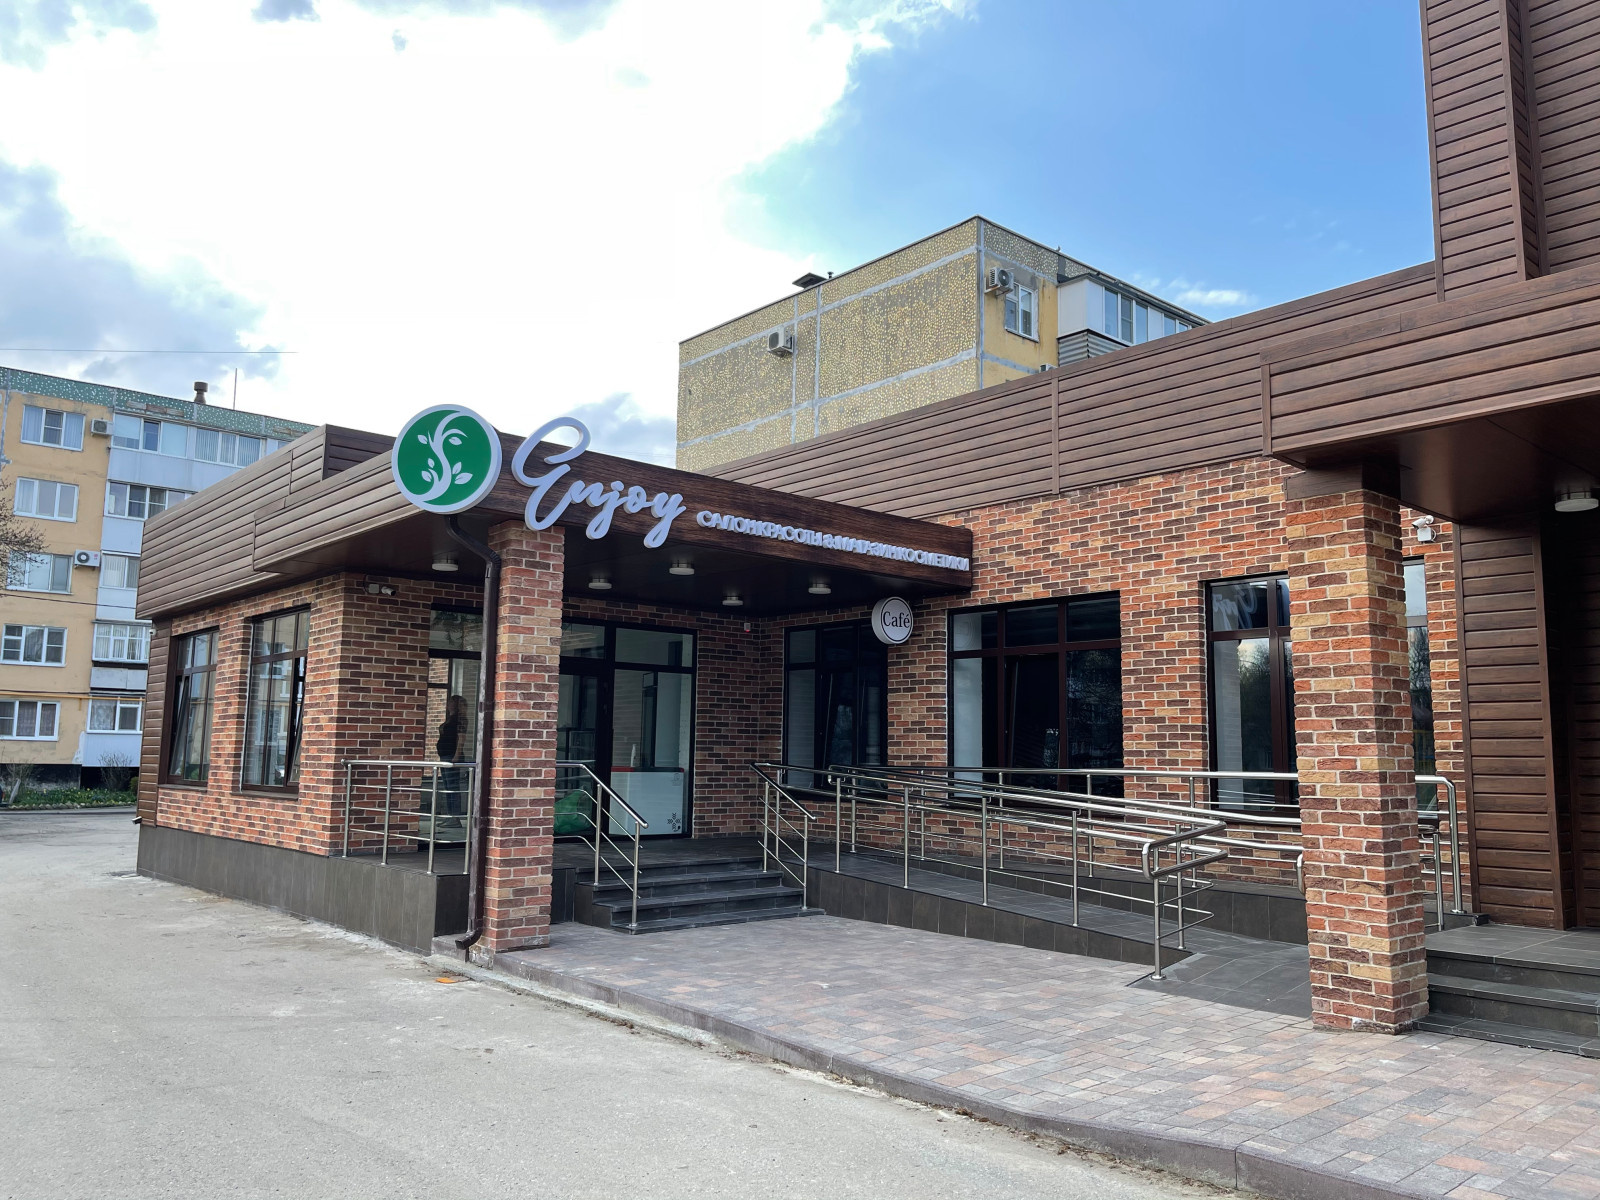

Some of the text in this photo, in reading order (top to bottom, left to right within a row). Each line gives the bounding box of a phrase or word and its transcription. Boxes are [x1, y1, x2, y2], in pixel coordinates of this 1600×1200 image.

[511, 416, 687, 548] Enjoy
[696, 510, 757, 535] САЛОН
[756, 521, 823, 547] КРАСОТЫ
[883, 611, 910, 628] Café
